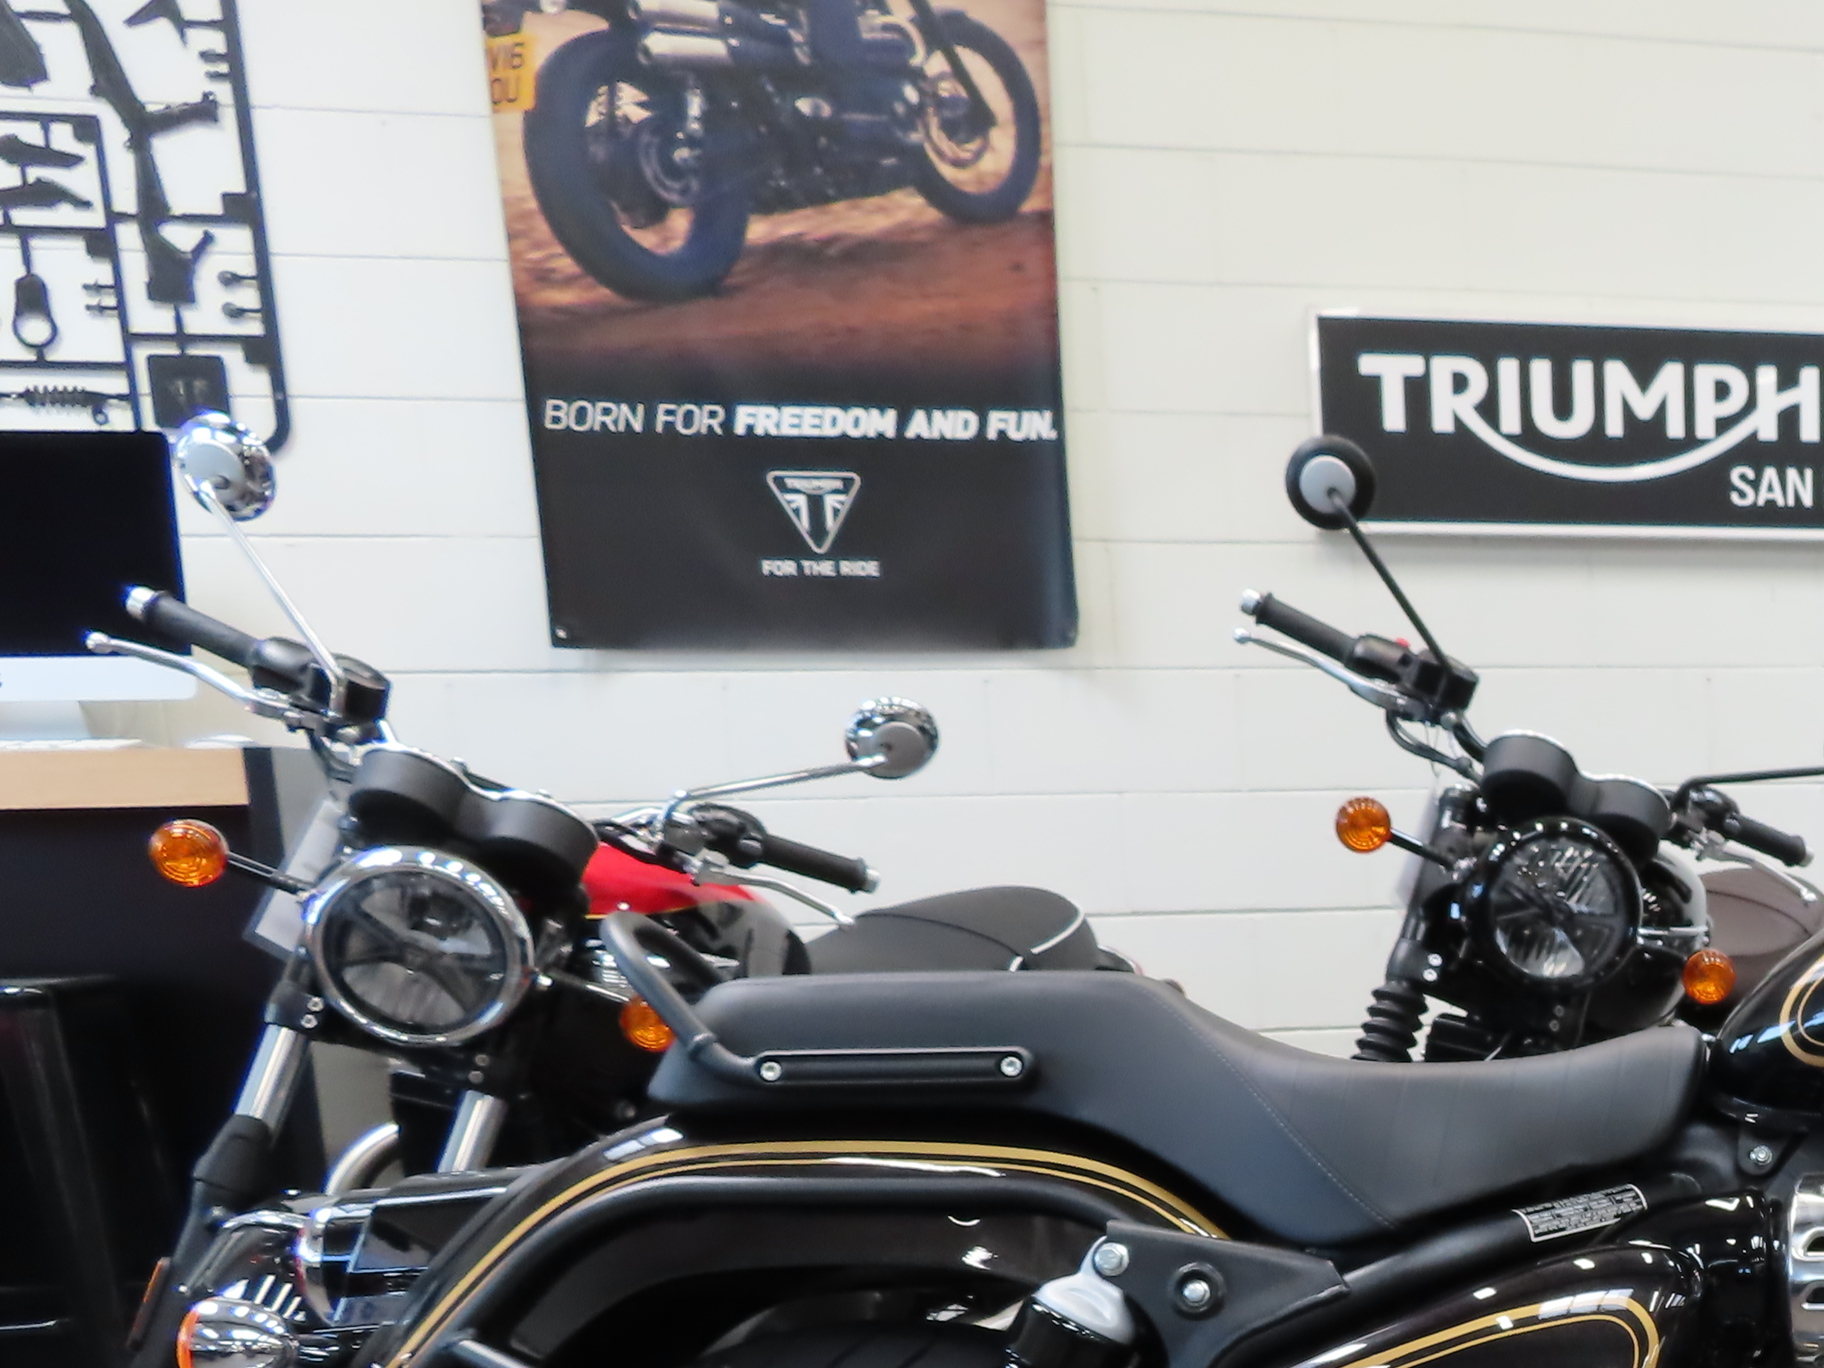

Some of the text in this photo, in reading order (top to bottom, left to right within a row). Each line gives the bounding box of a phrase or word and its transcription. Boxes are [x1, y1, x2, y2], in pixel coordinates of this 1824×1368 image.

[544, 399, 1059, 442] BORN FOR FREEDOM AND FUN.
[1357, 352, 1821, 483] TRIUMPH
[1729, 466, 1815, 509] SAN
[761, 559, 880, 577] FOR THE RIDE
